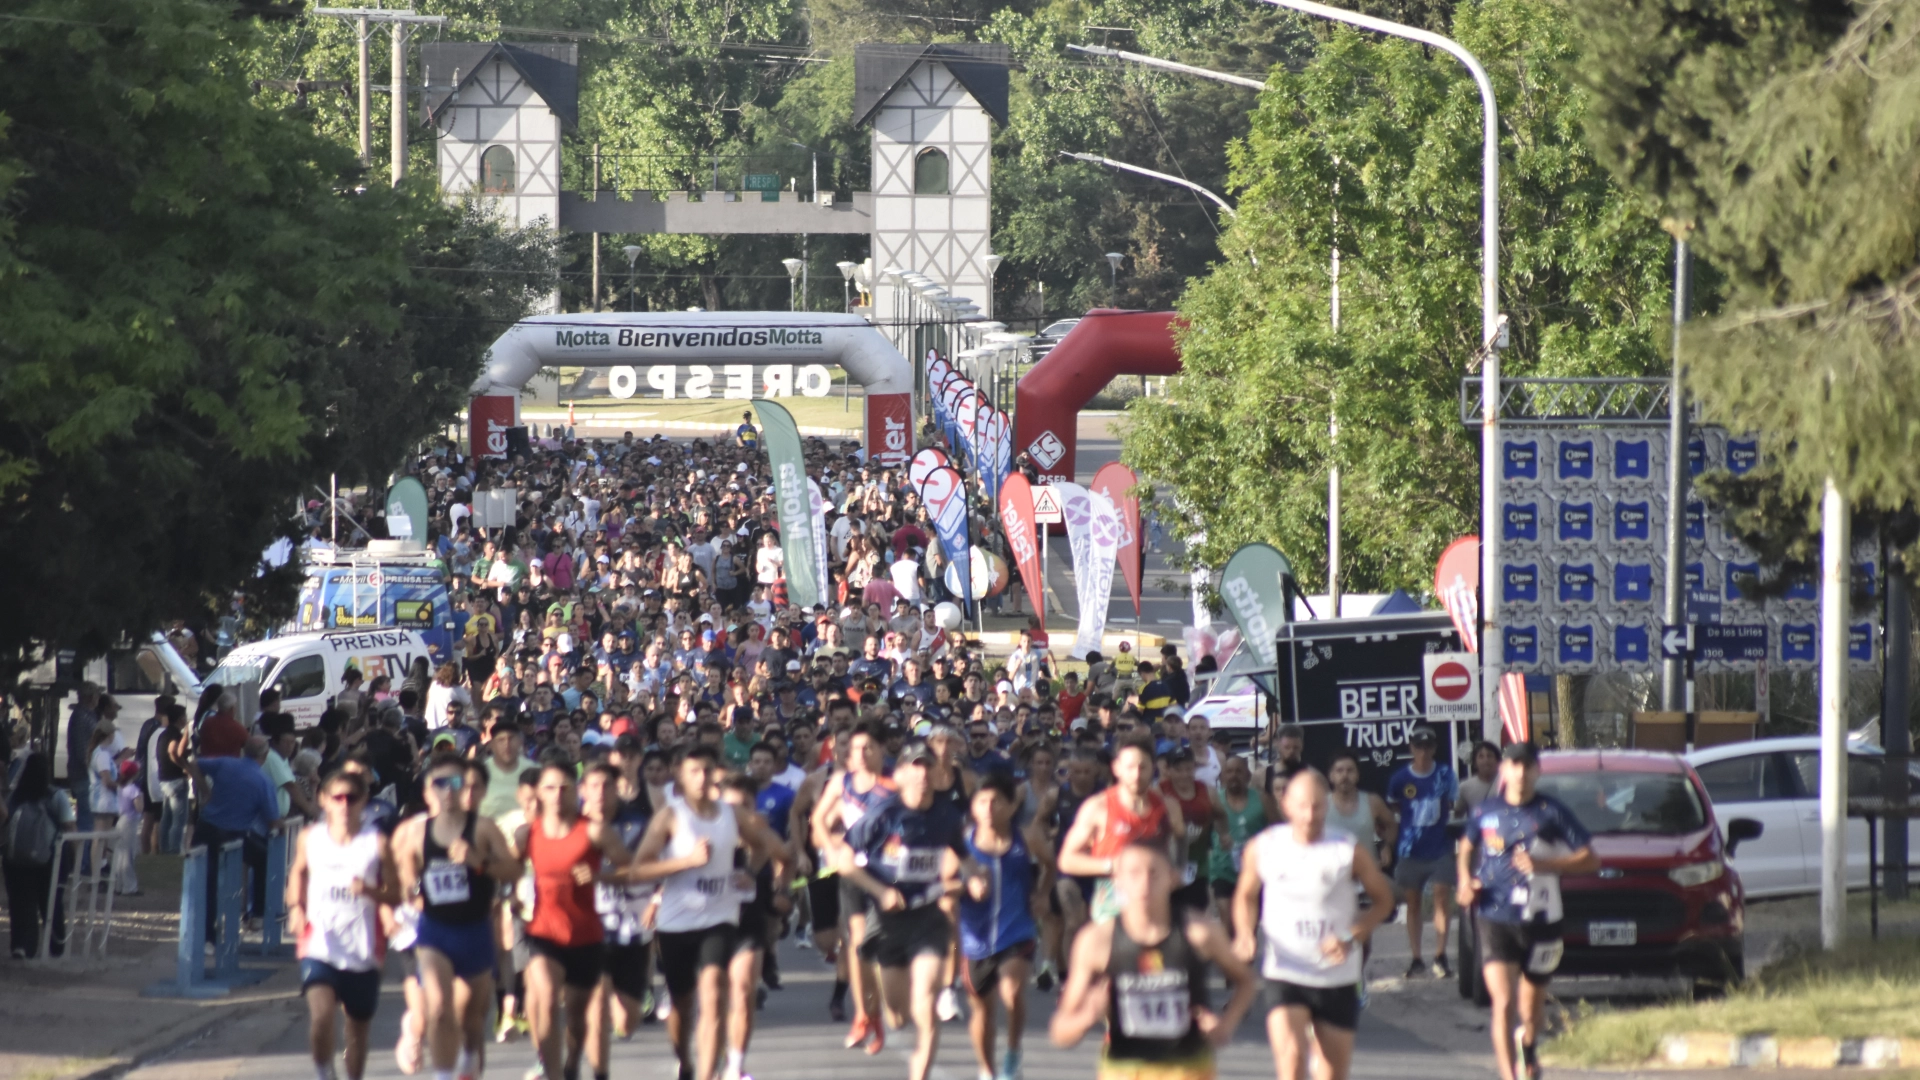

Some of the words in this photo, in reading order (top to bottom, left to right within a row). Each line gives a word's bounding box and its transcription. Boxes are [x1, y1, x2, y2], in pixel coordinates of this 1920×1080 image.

[556, 330, 611, 348] Motta
[617, 328, 768, 348] Bienvenidos
[768, 328, 823, 346] Motta
[384, 575, 422, 584] PRENSA
[1707, 626, 1720, 637] De
[1723, 627, 1736, 637] los
[1738, 626, 1763, 637] Lirios
[330, 632, 412, 652] PRENSA
[1704, 649, 1724, 658] 1300
[1743, 648, 1765, 657] 1400
[1340, 684, 1421, 719] BEER
[1428, 702, 1478, 715] CONTRAMANO
[1343, 719, 1417, 748] TRUCK
